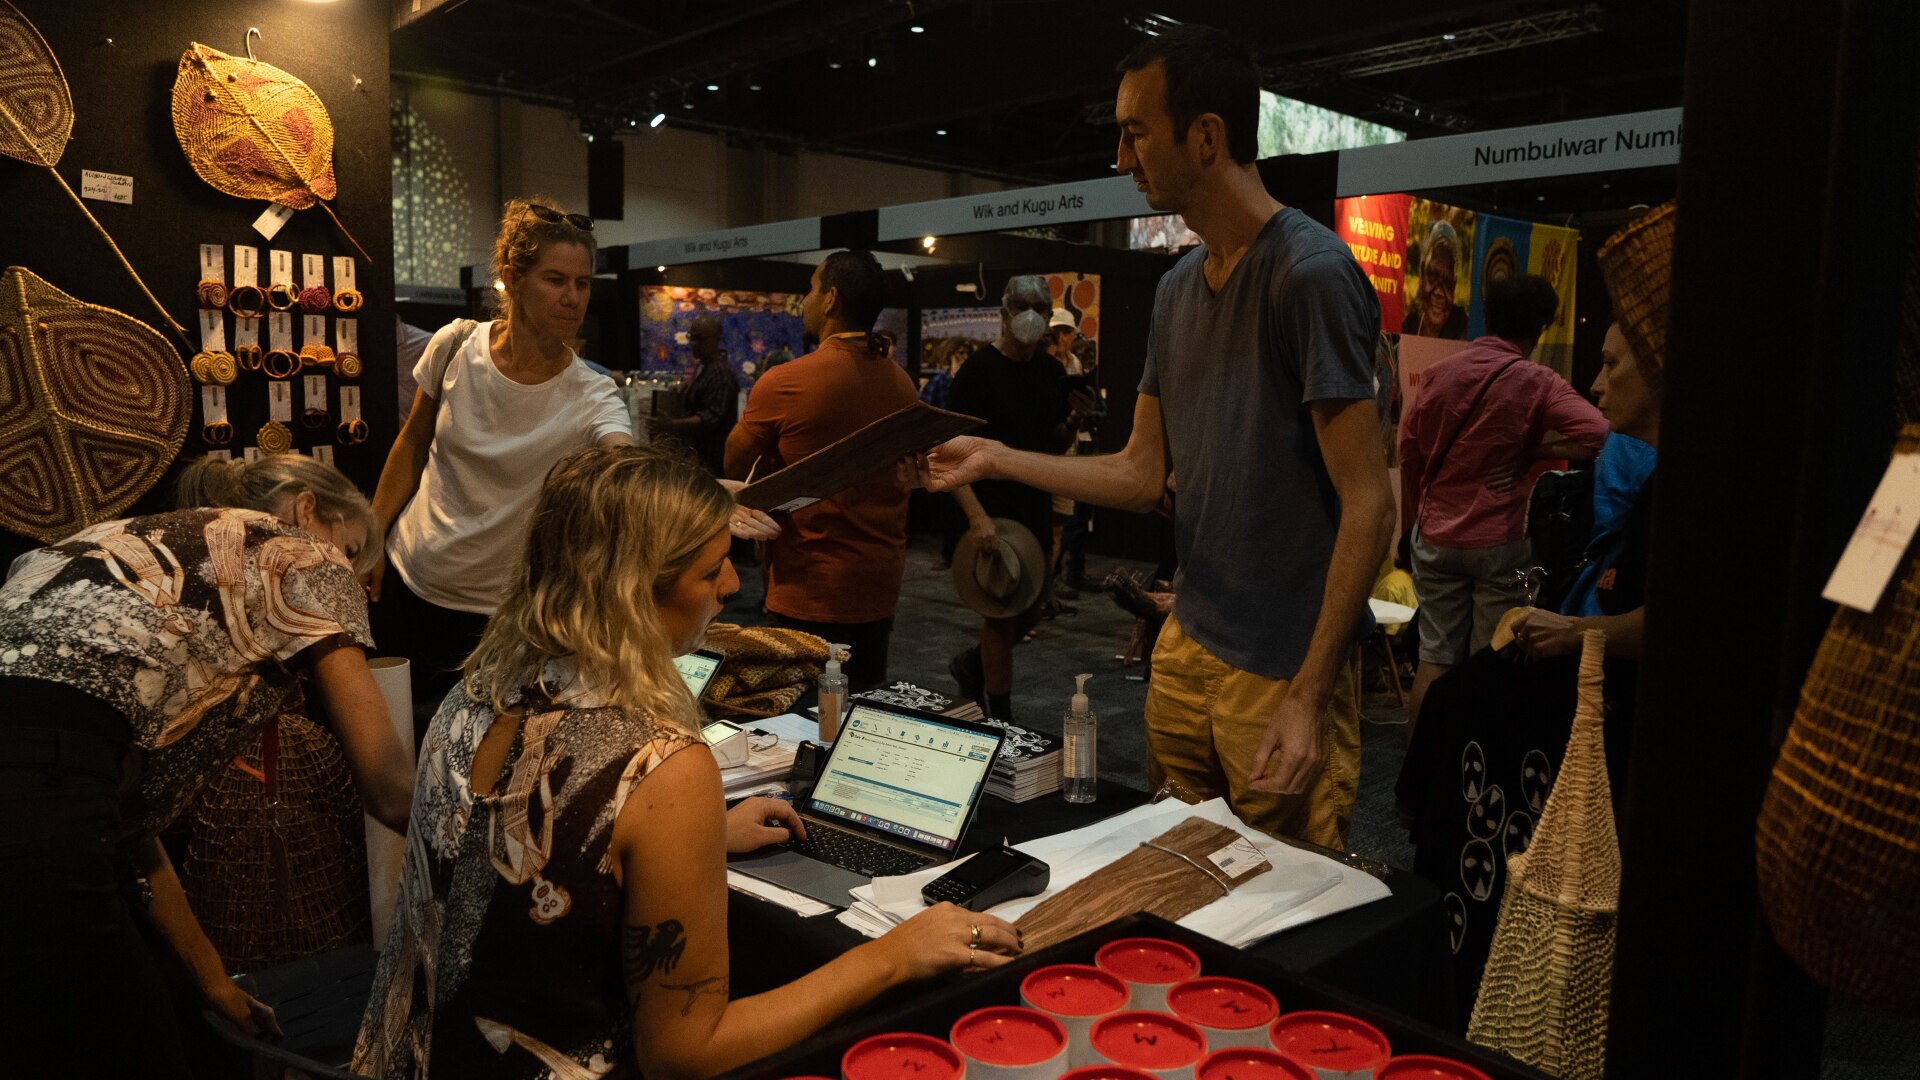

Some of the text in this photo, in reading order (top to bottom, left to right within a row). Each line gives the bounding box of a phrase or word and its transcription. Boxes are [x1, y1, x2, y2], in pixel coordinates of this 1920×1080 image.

[1474, 137, 1607, 166] Numbulwar
[973, 194, 1084, 219] Wik and Kugu Arts
[1348, 216, 1395, 242] WEAVING
[1380, 250, 1402, 270] AND
